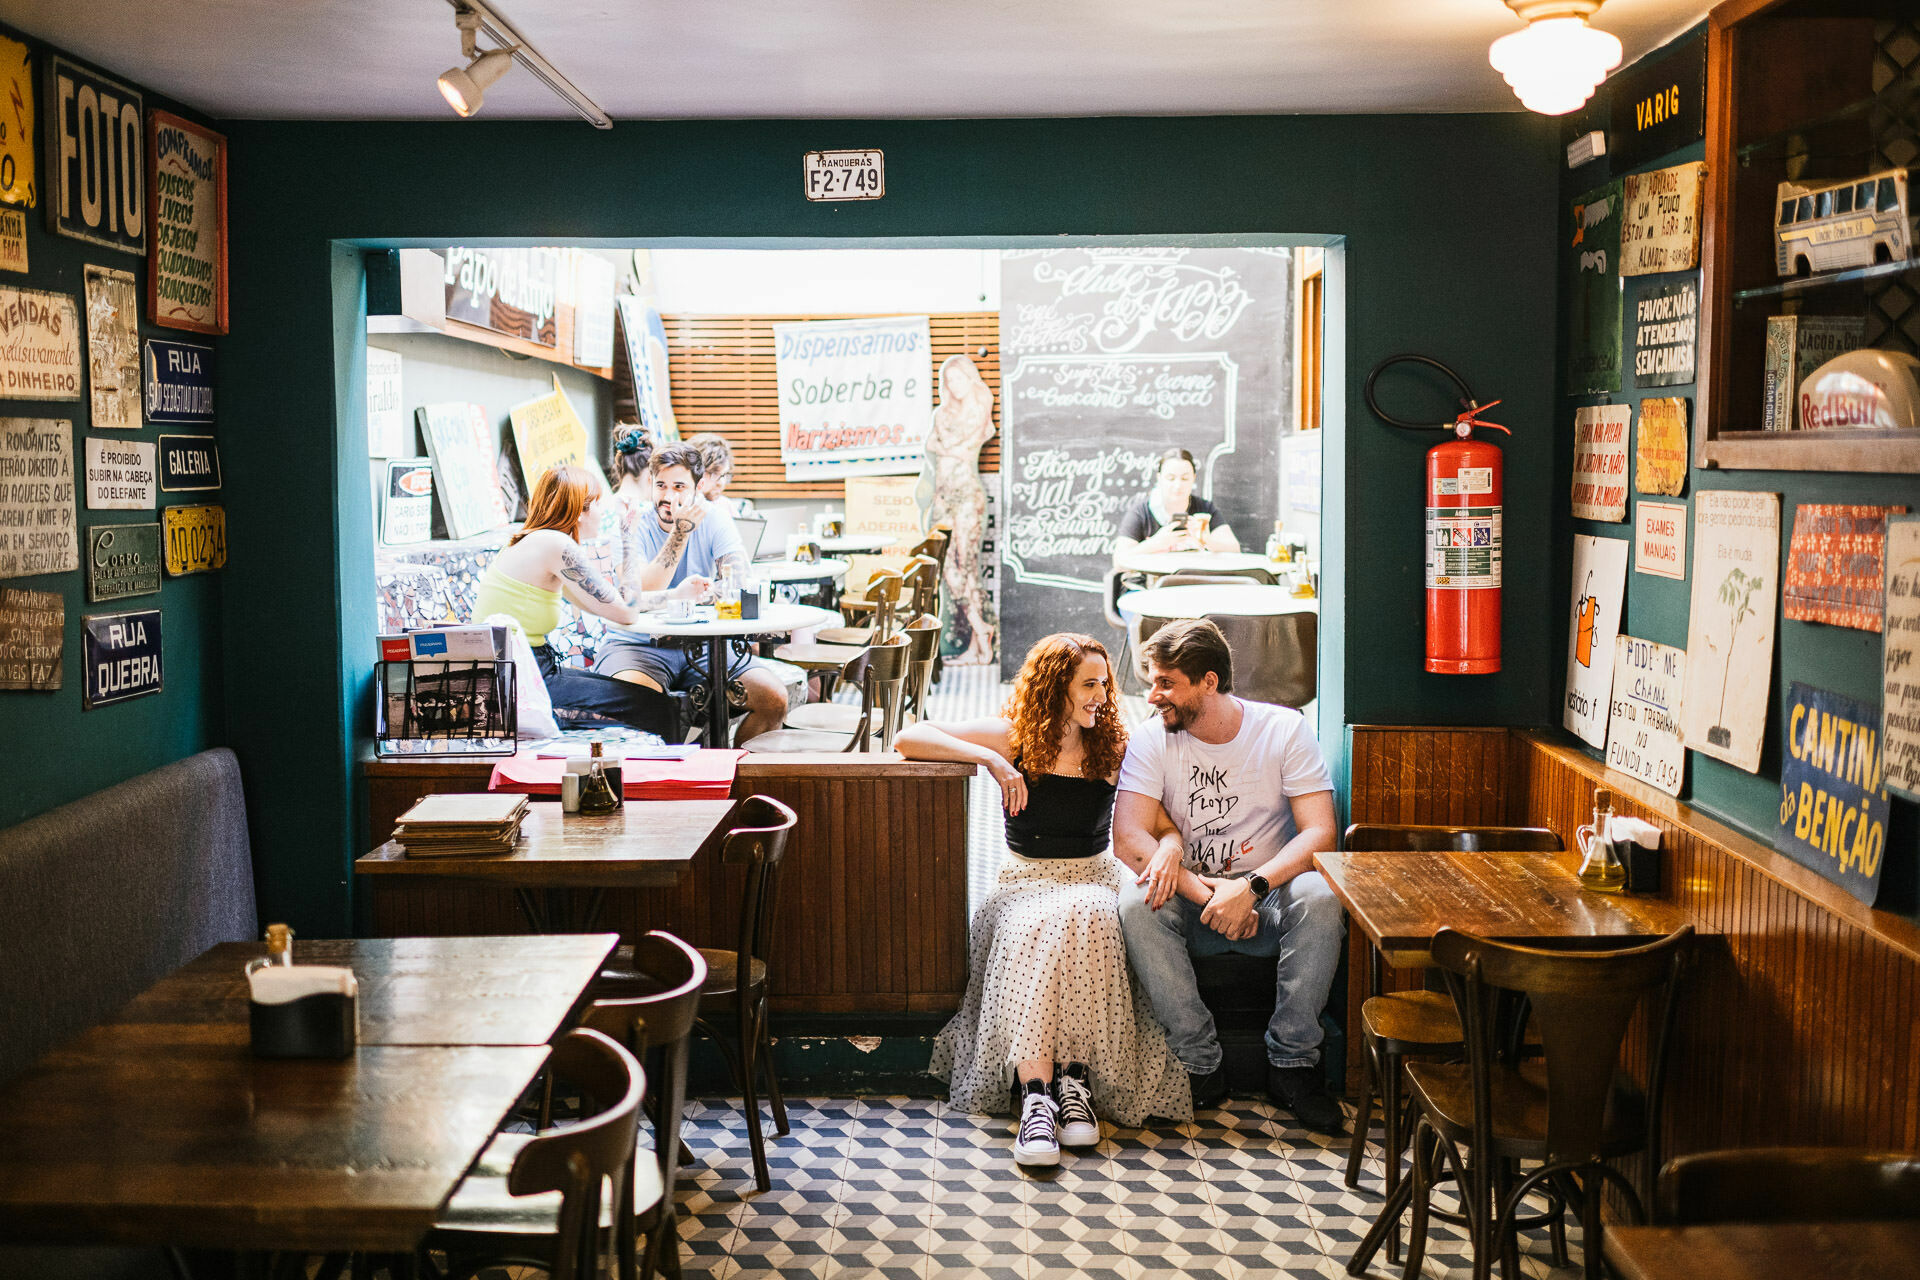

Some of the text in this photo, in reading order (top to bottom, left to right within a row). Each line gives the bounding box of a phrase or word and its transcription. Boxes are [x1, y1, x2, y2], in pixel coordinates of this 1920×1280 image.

[1636, 84, 1679, 132] VARIG
[58, 74, 142, 238] FOTO
[816, 158, 872, 168] TRANQUERAS
[1673, 286, 1696, 319] NÃO
[1636, 319, 1696, 347] ATENDEMOS
[168, 350, 202, 375] RUA
[8, 370, 75, 391] DINHEIRO
[788, 373, 917, 405] Soberba e
[1764, 402, 1774, 432] CRACK
[1802, 393, 1878, 430] Red Bull
[107, 452, 141, 466] PROIBIDO
[169, 449, 211, 475] GALERIA
[89, 469, 153, 486] SUBIR NA CABEÇA
[54, 483, 72, 502] QUE
[98, 487, 146, 500] DO ELEFANTE
[872, 495, 914, 506] SEBO
[13, 533, 25, 550] EM
[1646, 518, 1675, 537] EXAMES
[96, 530, 140, 567] CORPO
[1643, 542, 1677, 562] MANUAIS
[109, 621, 147, 649] RUA
[1626, 641, 1677, 678] PODE ME
[98, 654, 159, 696] QUEBRA
[1612, 700, 1637, 722] ESTOU
[1635, 731, 1648, 749] NO
[1189, 765, 1228, 793] PINK
[1656, 759, 1678, 788] CASA
[1188, 786, 1239, 819] FLOYD
[1780, 784, 1796, 826] da
